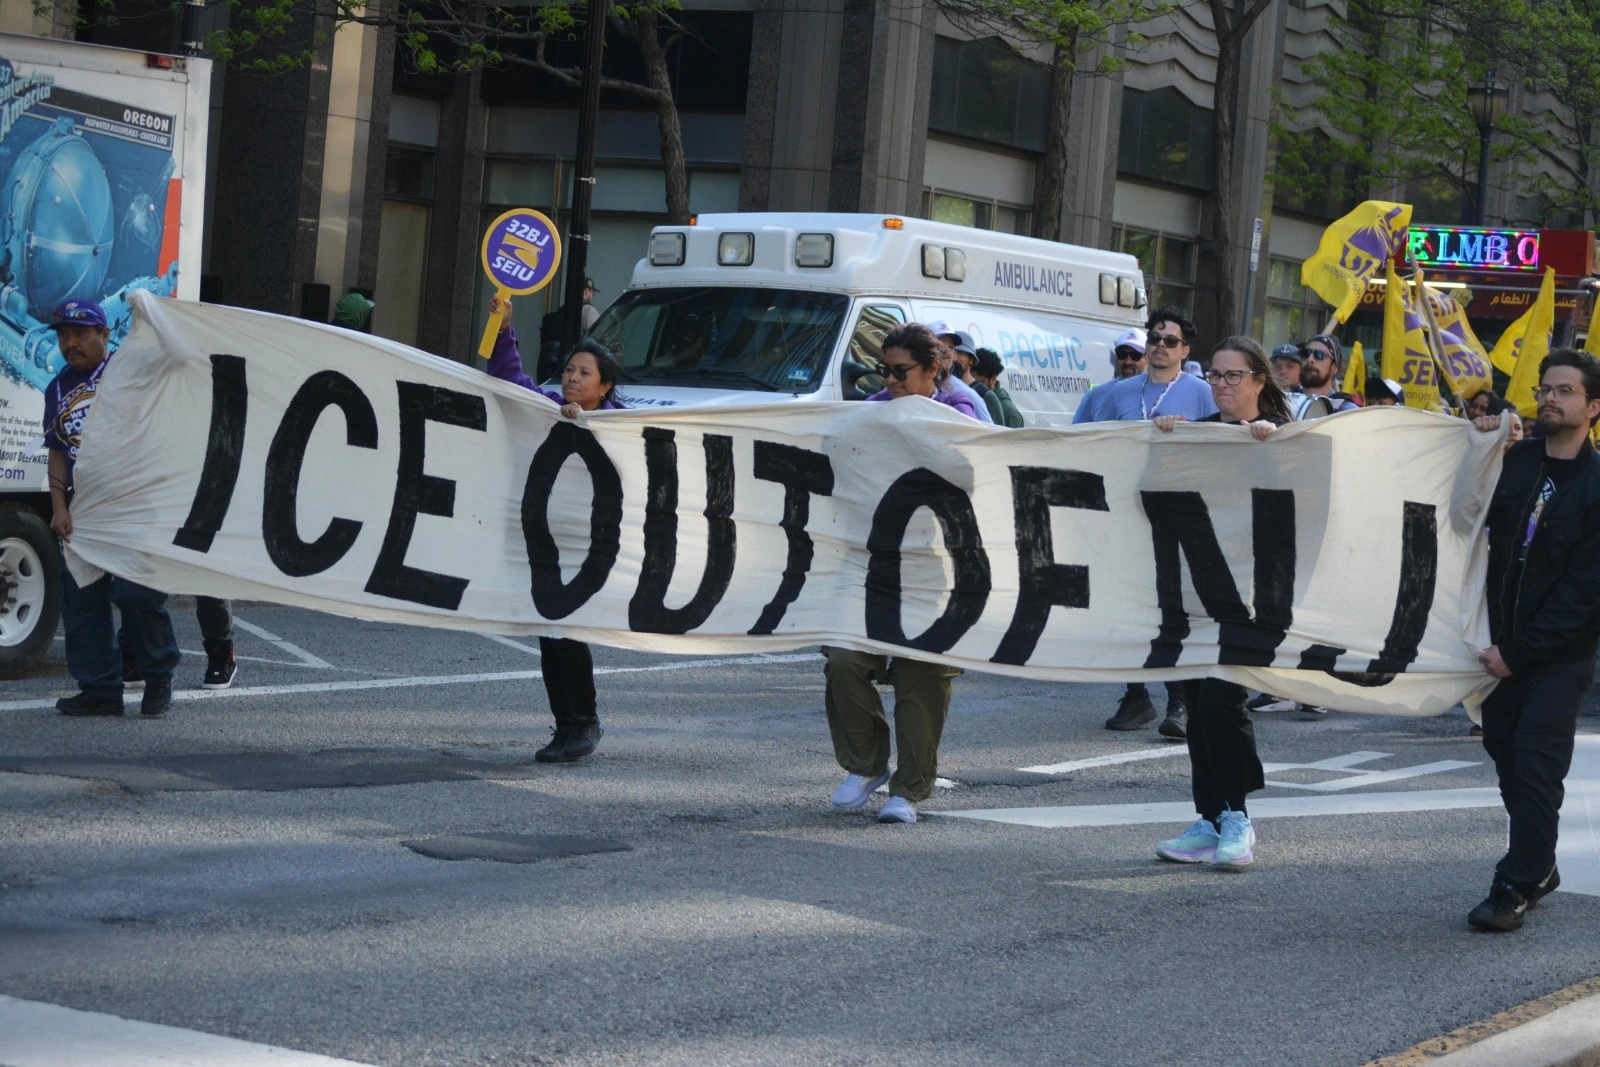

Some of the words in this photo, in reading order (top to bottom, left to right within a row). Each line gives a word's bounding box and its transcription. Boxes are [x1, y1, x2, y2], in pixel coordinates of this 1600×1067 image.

[0, 84, 51, 143] America
[123, 109, 170, 132] OREGON
[505, 218, 551, 247] 32BJ
[491, 256, 535, 282] SEIU
[994, 260, 1074, 298] AMBULANCE
[998, 331, 1088, 371] PACIFIC
[1007, 373, 1037, 392] MEDICAL
[1037, 375, 1091, 395] TRANSPORTATION
[172, 354, 487, 611] ICE
[521, 420, 835, 635] OUT
[865, 465, 1111, 667] OF
